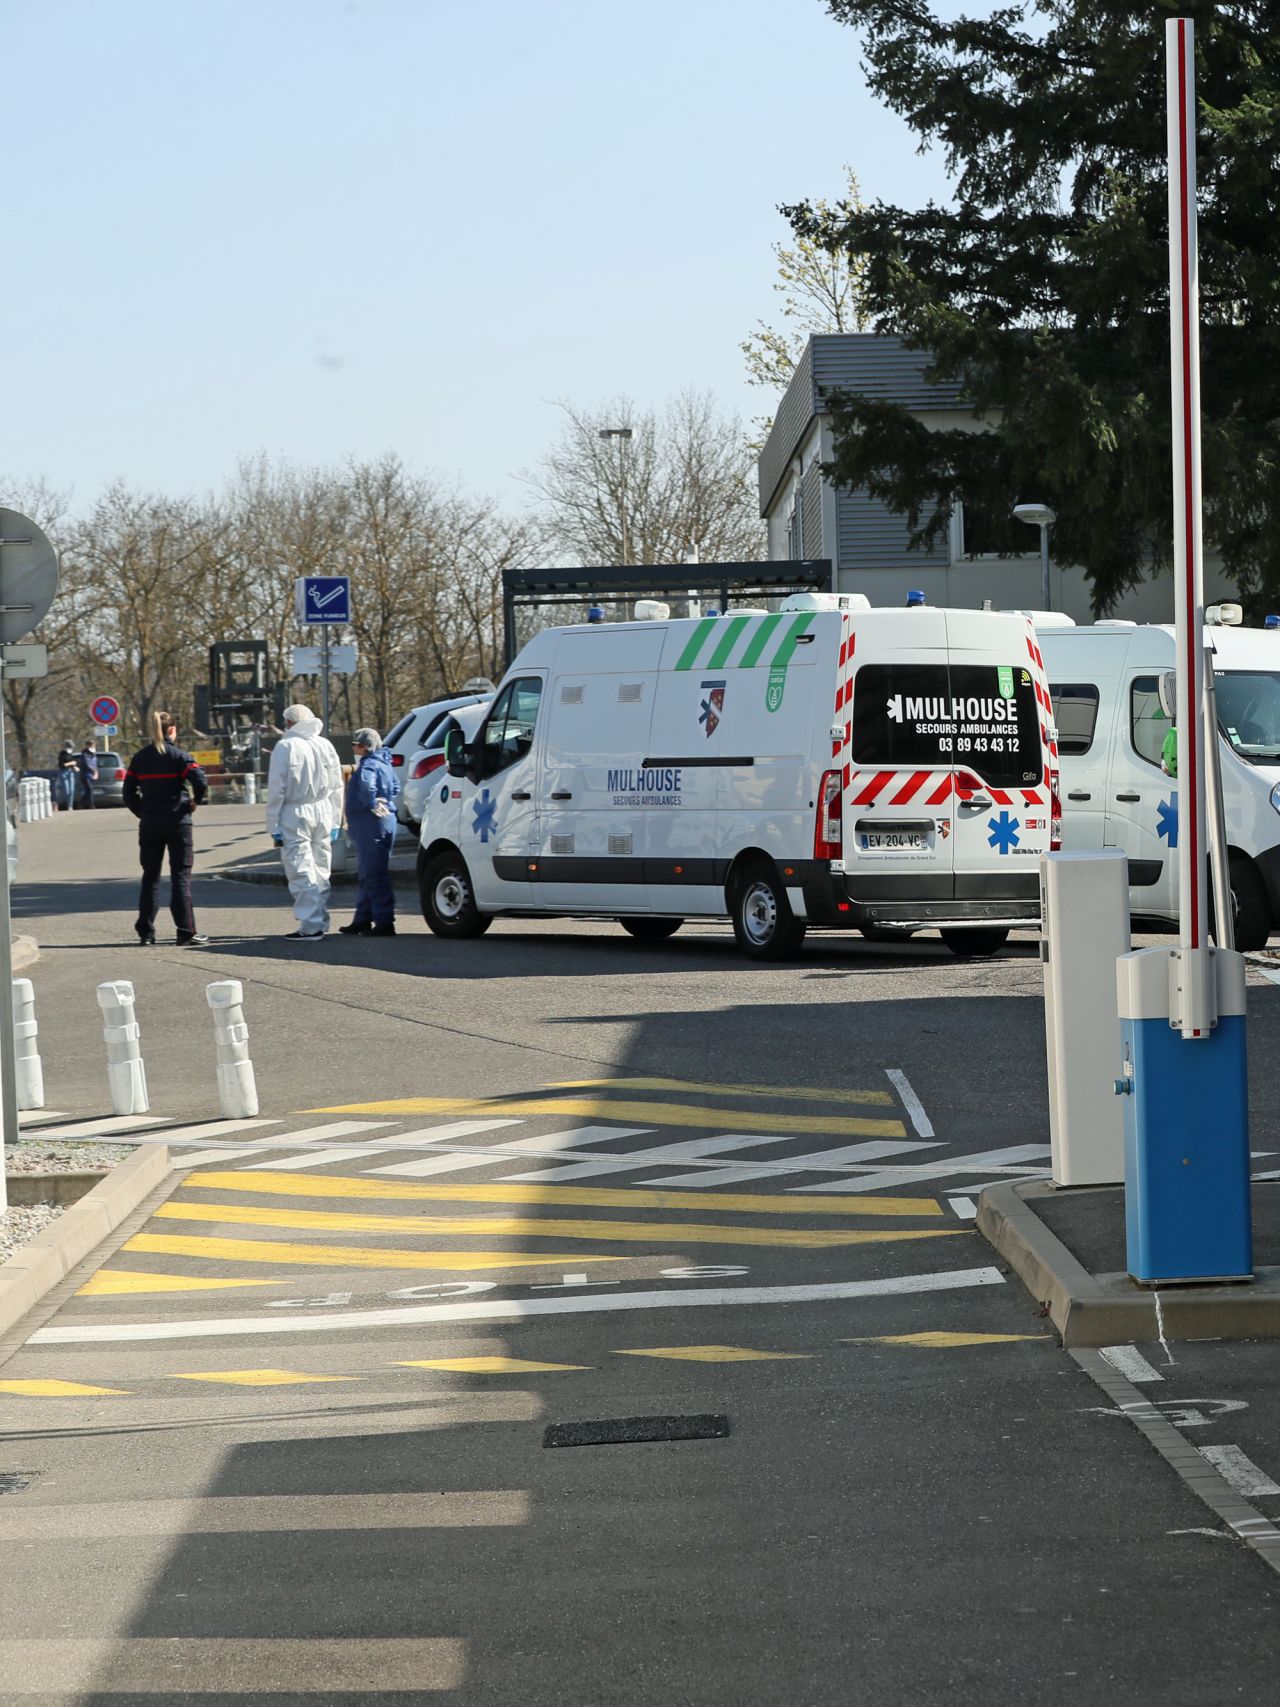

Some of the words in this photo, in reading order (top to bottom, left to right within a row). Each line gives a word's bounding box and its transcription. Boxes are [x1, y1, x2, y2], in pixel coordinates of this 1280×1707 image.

[906, 697, 1018, 721] MULHOUSE
[916, 723, 958, 734] SECOURS
[960, 725, 1018, 735] AMBULANCES
[939, 738, 952, 752] 03
[957, 738, 971, 752] 89
[974, 738, 988, 752] 43
[991, 738, 1004, 752] 43
[1006, 739, 1019, 752] 12
[607, 769, 682, 792] MULHOUSE
[612, 795, 640, 806] SECOURS
[641, 795, 682, 806] AMBULANCES
